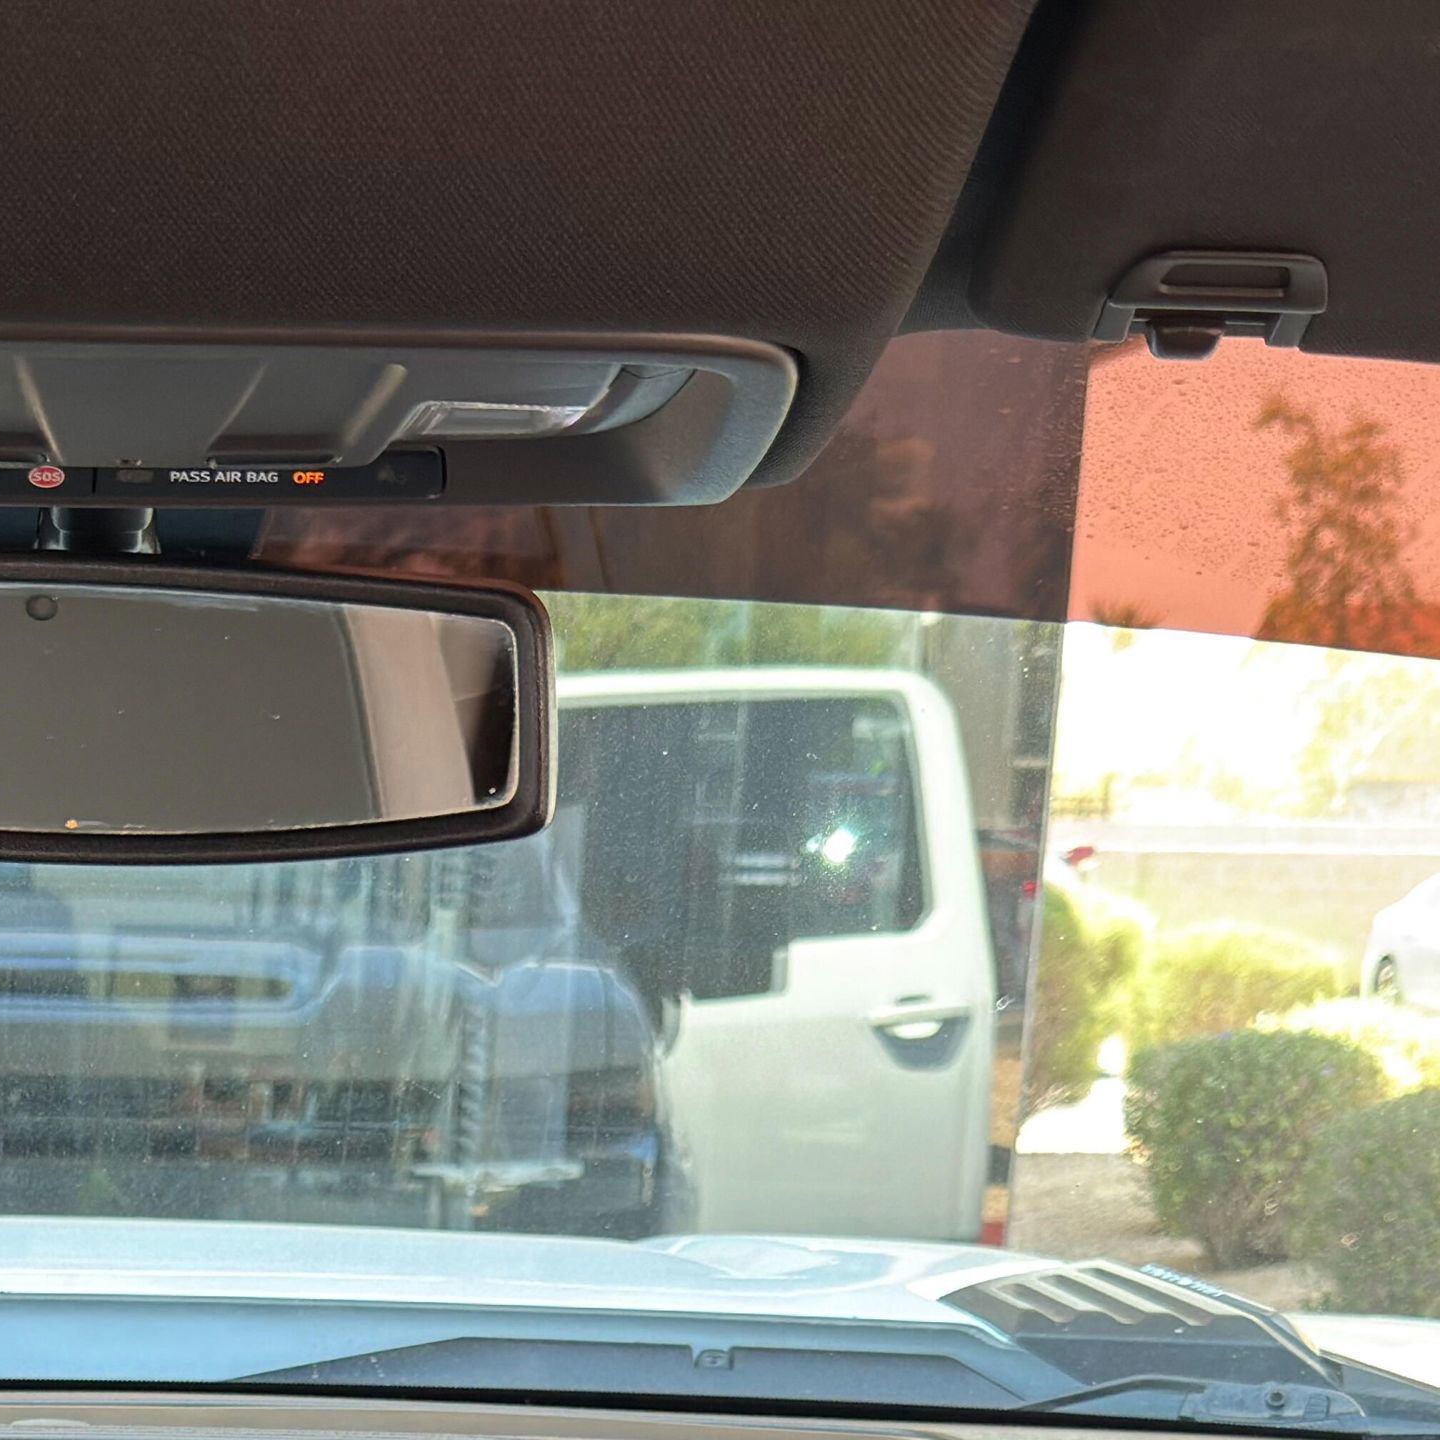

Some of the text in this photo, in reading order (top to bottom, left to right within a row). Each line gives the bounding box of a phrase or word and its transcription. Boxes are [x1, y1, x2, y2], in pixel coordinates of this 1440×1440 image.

[32, 470, 62, 483] SOS
[170, 471, 279, 483] PASS AIR BAG
[292, 471, 325, 484] OFF
